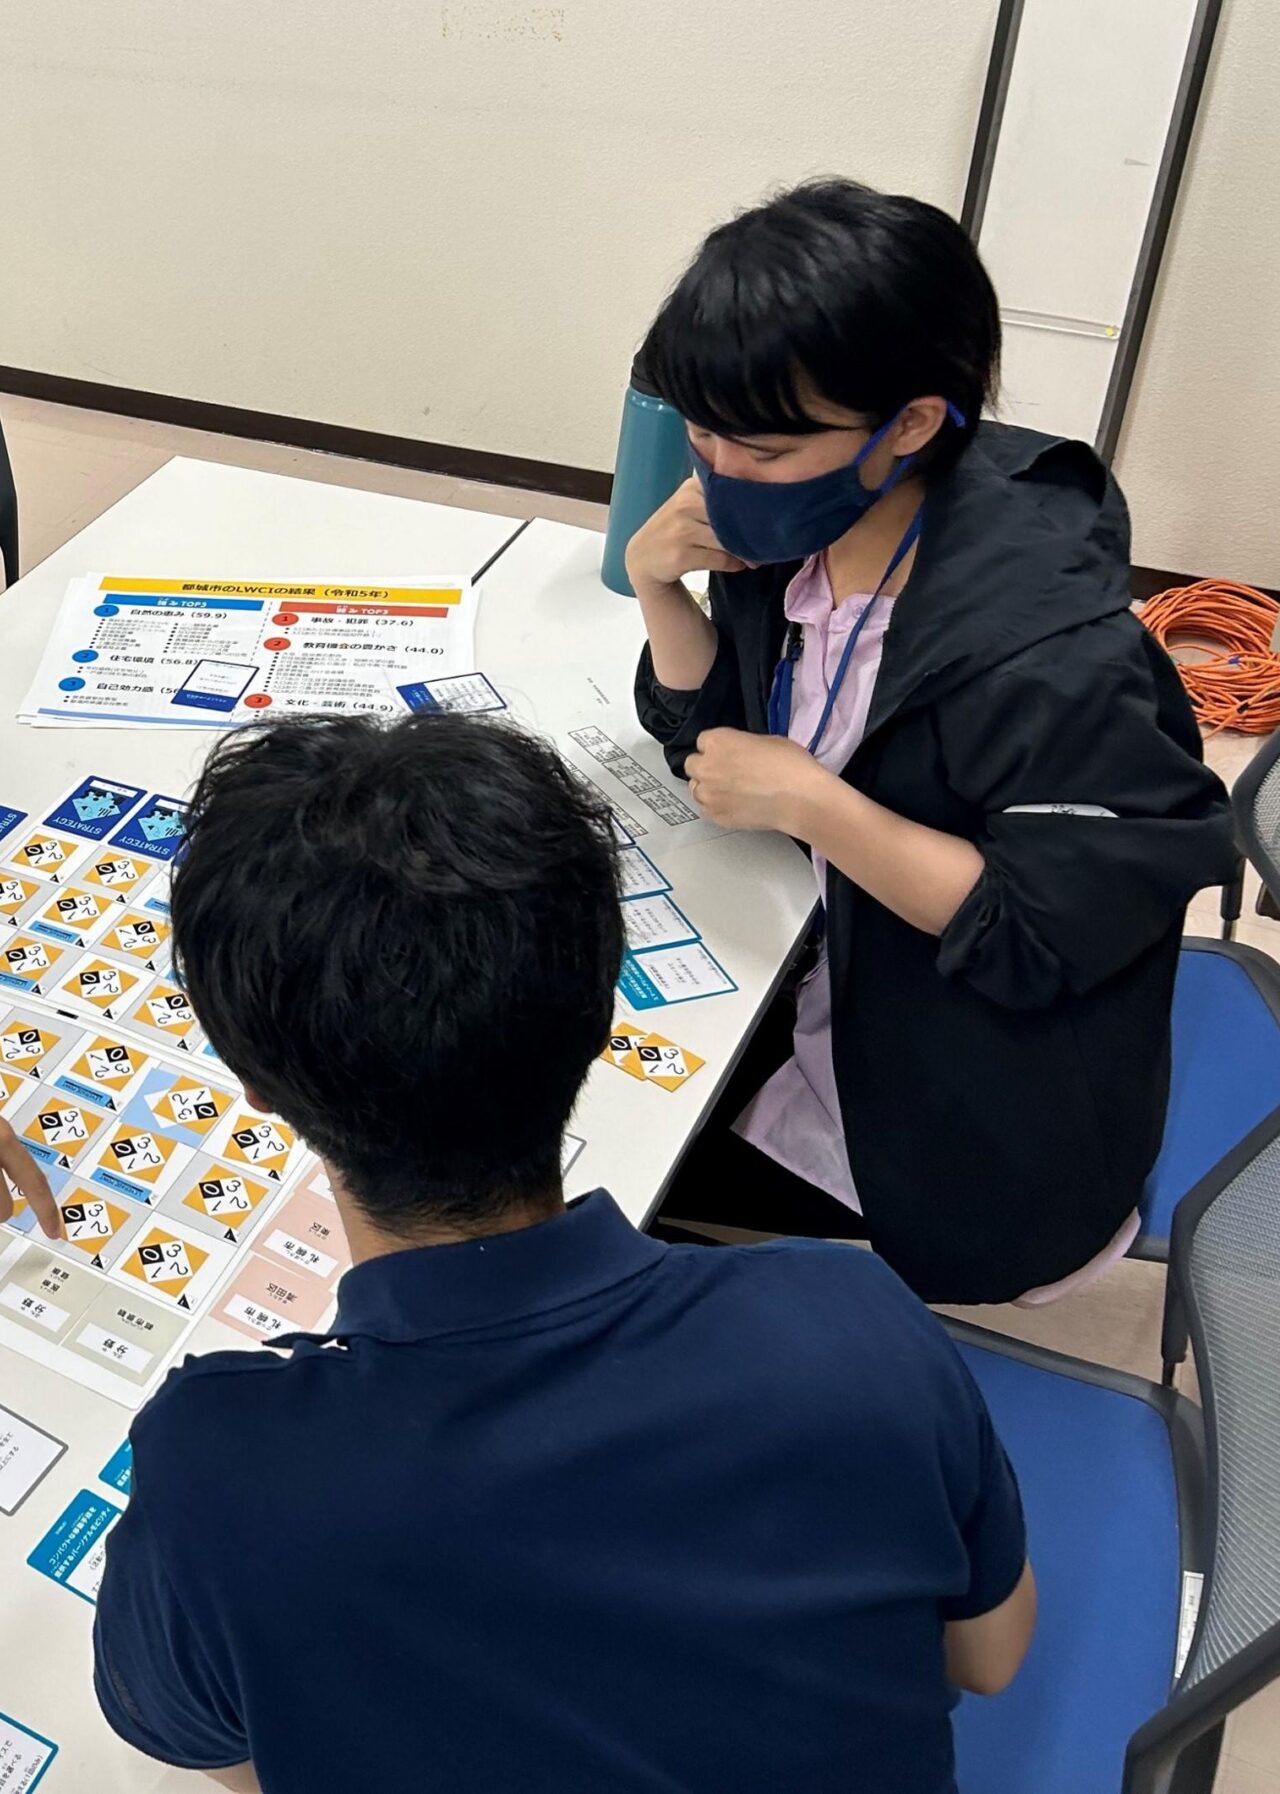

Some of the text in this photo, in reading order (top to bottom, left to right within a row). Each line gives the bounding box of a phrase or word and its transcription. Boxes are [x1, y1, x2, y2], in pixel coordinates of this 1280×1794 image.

[52, 816, 103, 835] STRATEGY
[118, 835, 171, 856] STRATEGY
[6, 881, 18, 890] 3
[8, 892, 23, 900] 2
[110, 1048, 124, 1060] 0
[641, 1048, 657, 1059] 0
[664, 1049, 679, 1059] 3
[95, 1066, 110, 1078] 2
[114, 1064, 130, 1074] 3
[667, 1063, 684, 1075] 2
[172, 1094, 189, 1105] 2
[178, 1108, 192, 1121] 3
[198, 1105, 215, 1116] 0
[42, 1115, 58, 1126] 0
[64, 1111, 78, 1123] 3
[68, 1126, 85, 1138] 2
[137, 1137, 151, 1149] 3
[237, 1134, 254, 1144] 0
[259, 1126, 272, 1138] 3
[267, 1141, 285, 1151] 2
[115, 1143, 132, 1154] 0
[143, 1152, 161, 1164] 2
[203, 1184, 220, 1195] 0
[226, 1180, 241, 1192] 3
[230, 1196, 248, 1209] 2
[65, 1208, 81, 1220] 0
[88, 1204, 104, 1217] 3
[90, 1221, 109, 1234] 2
[142, 1248, 160, 1261] 0
[166, 1244, 182, 1258] 3
[282, 1239, 320, 1264] 札幌市
[170, 1262, 188, 1275] 2
[20, 1296, 47, 1314] 分野
[243, 1304, 282, 1330] 札幌市
[102, 1335, 129, 1355] 分野
